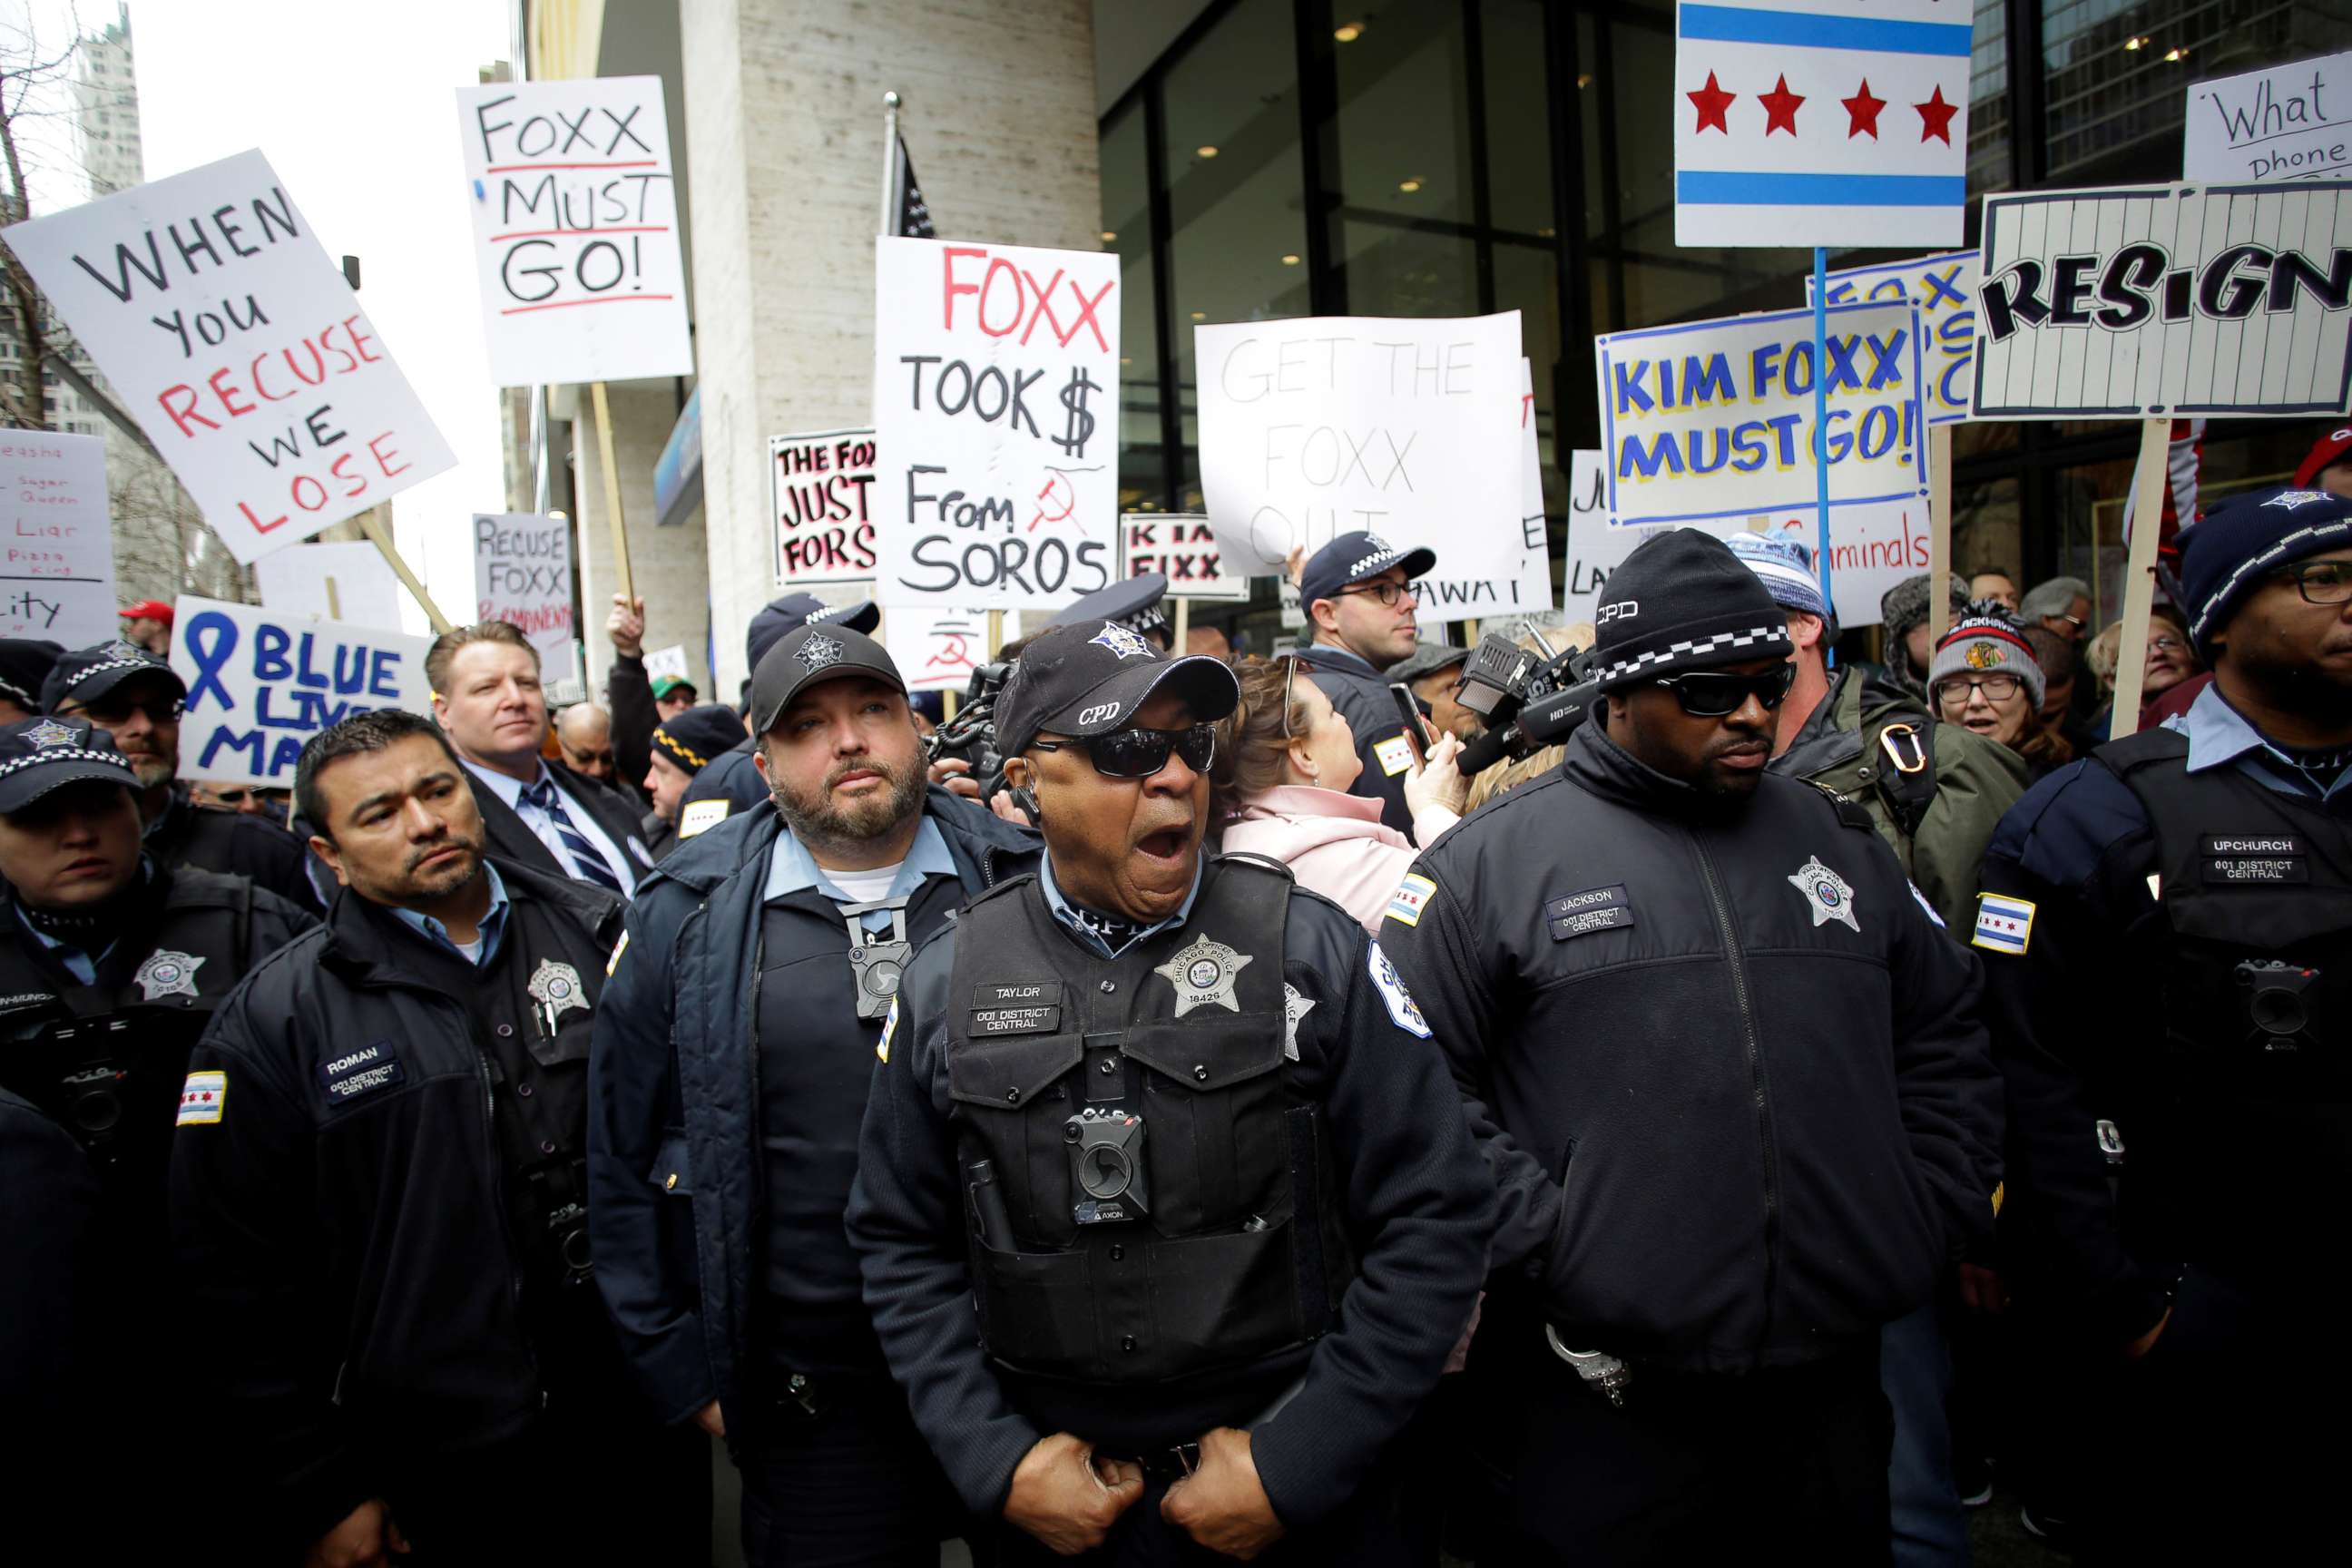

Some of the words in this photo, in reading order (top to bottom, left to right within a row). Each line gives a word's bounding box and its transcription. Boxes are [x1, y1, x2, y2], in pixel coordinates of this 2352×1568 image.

[2211, 71, 2328, 142] What
[503, 172, 673, 231] MUST
[72, 187, 299, 303] WHEN
[501, 234, 642, 303] GO!
[942, 246, 1116, 354] FOXX
[1979, 240, 2352, 344] RESIGN
[157, 314, 384, 438] RECUSE
[1221, 337, 1356, 404] GET
[1373, 341, 1475, 398] THE
[1615, 352, 1737, 416] KIM
[1750, 328, 1908, 399] FOXX
[899, 355, 1046, 439] TOOK
[1050, 365, 1104, 459] $
[249, 405, 348, 469] WE
[1619, 414, 1802, 479] MUST
[1814, 400, 1917, 464] GO!
[778, 444, 830, 476] THE
[1265, 424, 1417, 492] FOXX
[237, 430, 413, 535] LOSE
[783, 474, 877, 528] JUST
[475, 517, 565, 561] RECUSE
[1250, 505, 1389, 564] OUT
[488, 562, 566, 596] FOXX
[897, 534, 1108, 596] SOROS
[1132, 553, 1220, 581] FIXX
[0, 591, 62, 629] ity
[253, 623, 402, 698] BLUE
[1079, 701, 1121, 726] CPD
[2213, 840, 2294, 851] UPCHURCH
[2215, 860, 2234, 870] 001
[2238, 860, 2293, 870] DISTRICT
[2227, 869, 2284, 878] CENTRAL
[1561, 890, 1612, 912] JACKSON
[1563, 916, 1578, 926] 001
[1579, 907, 1620, 922] DISTRICT
[1572, 916, 1615, 932] CENTRAL
[1175, 949, 1205, 983] CHICAGO
[1210, 949, 1233, 976] POLICE
[995, 986, 1041, 999] TAYLOR
[976, 1012, 995, 1022] 001
[999, 1007, 1051, 1020] DISTRICT
[986, 1018, 1038, 1031] CENTRAL
[327, 1046, 378, 1075] ROMAN
[330, 1080, 349, 1093] 001
[348, 1063, 395, 1084] DISTRICT
[341, 1075, 389, 1095] CENTRAL
[1102, 1211, 1123, 1220] AXON
